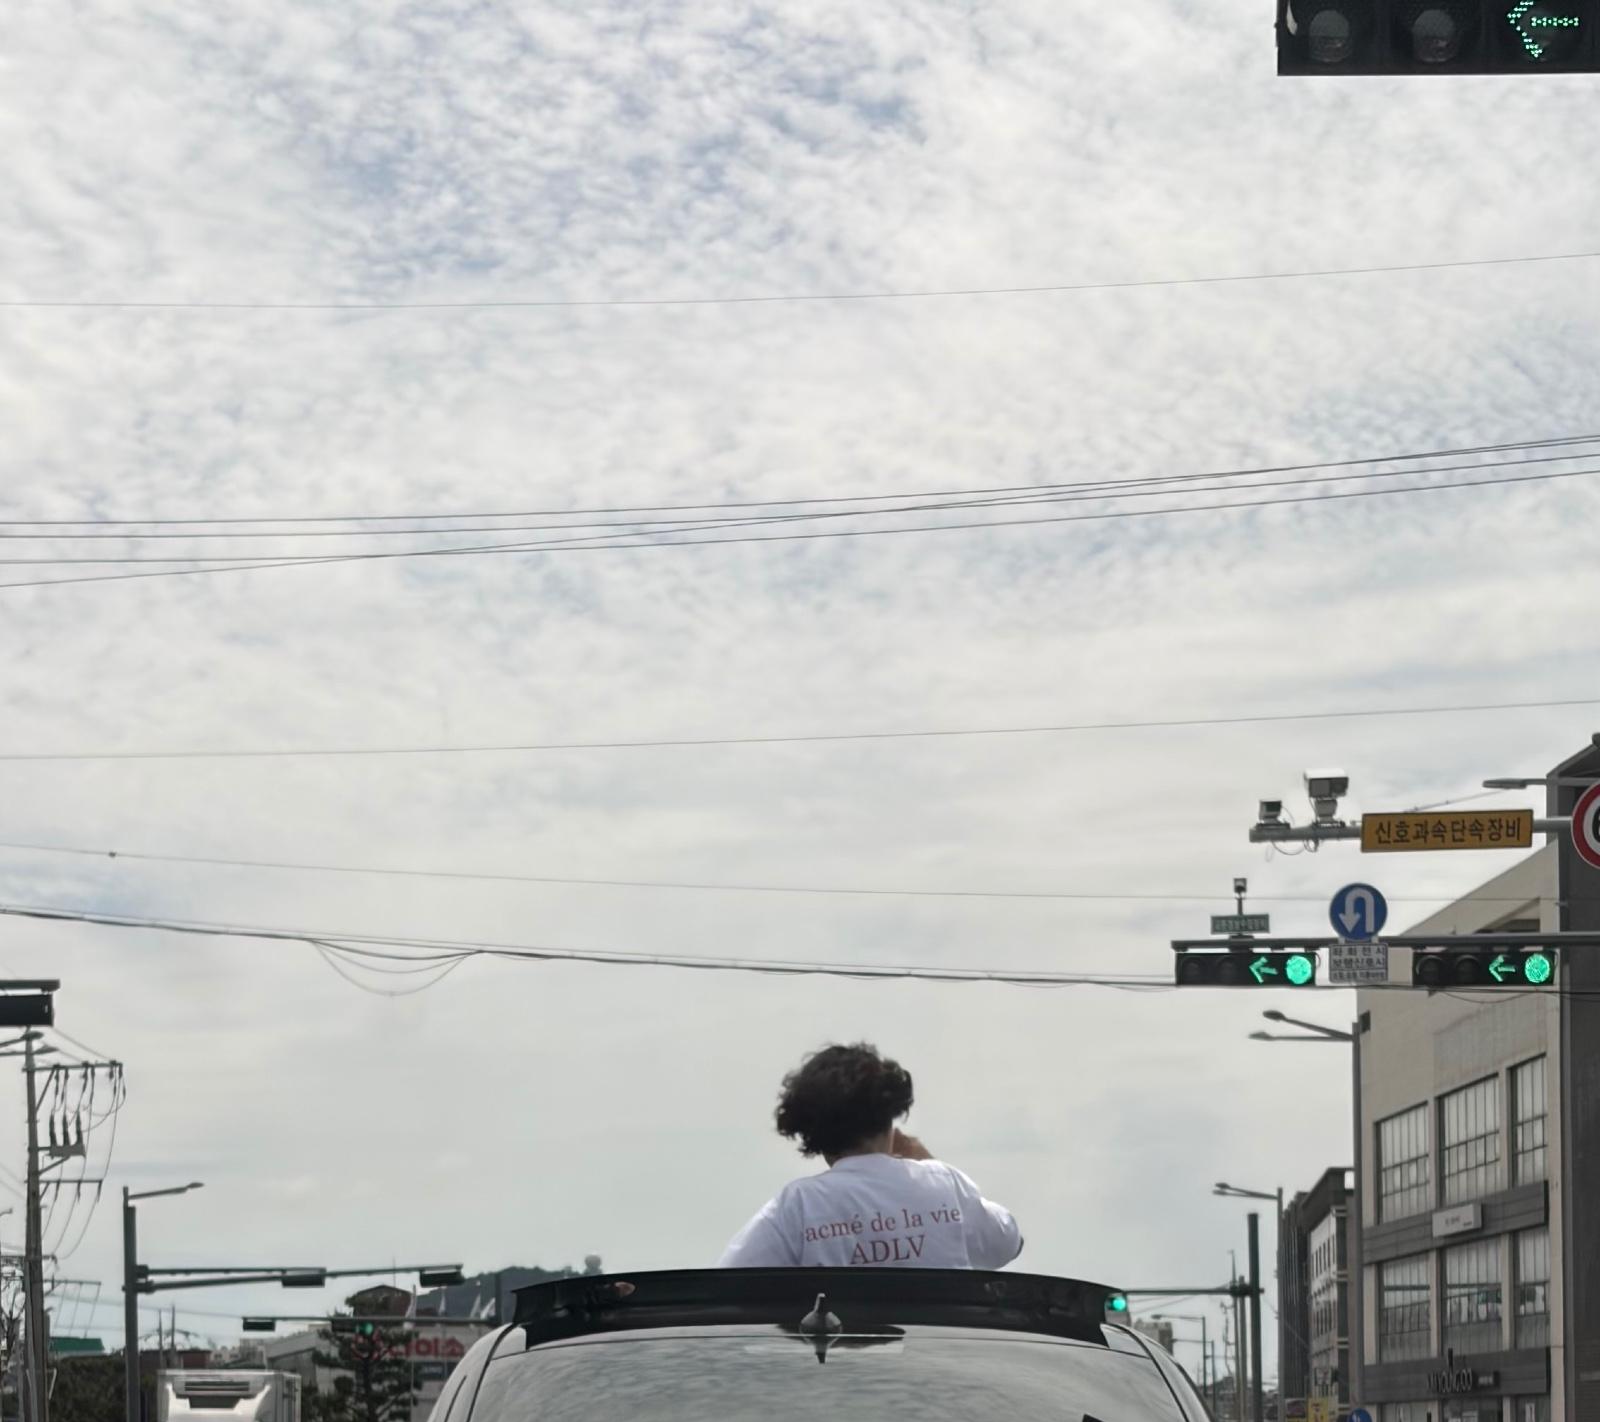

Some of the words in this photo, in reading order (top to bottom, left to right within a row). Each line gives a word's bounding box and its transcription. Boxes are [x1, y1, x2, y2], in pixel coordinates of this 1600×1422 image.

[1375, 818, 1521, 845] 신호과속단속장비
[805, 1214, 864, 1242] acmé
[870, 1212, 896, 1232] de
[902, 1208, 924, 1229] la
[930, 1203, 961, 1224] vie
[850, 1234, 926, 1265] ADLV
